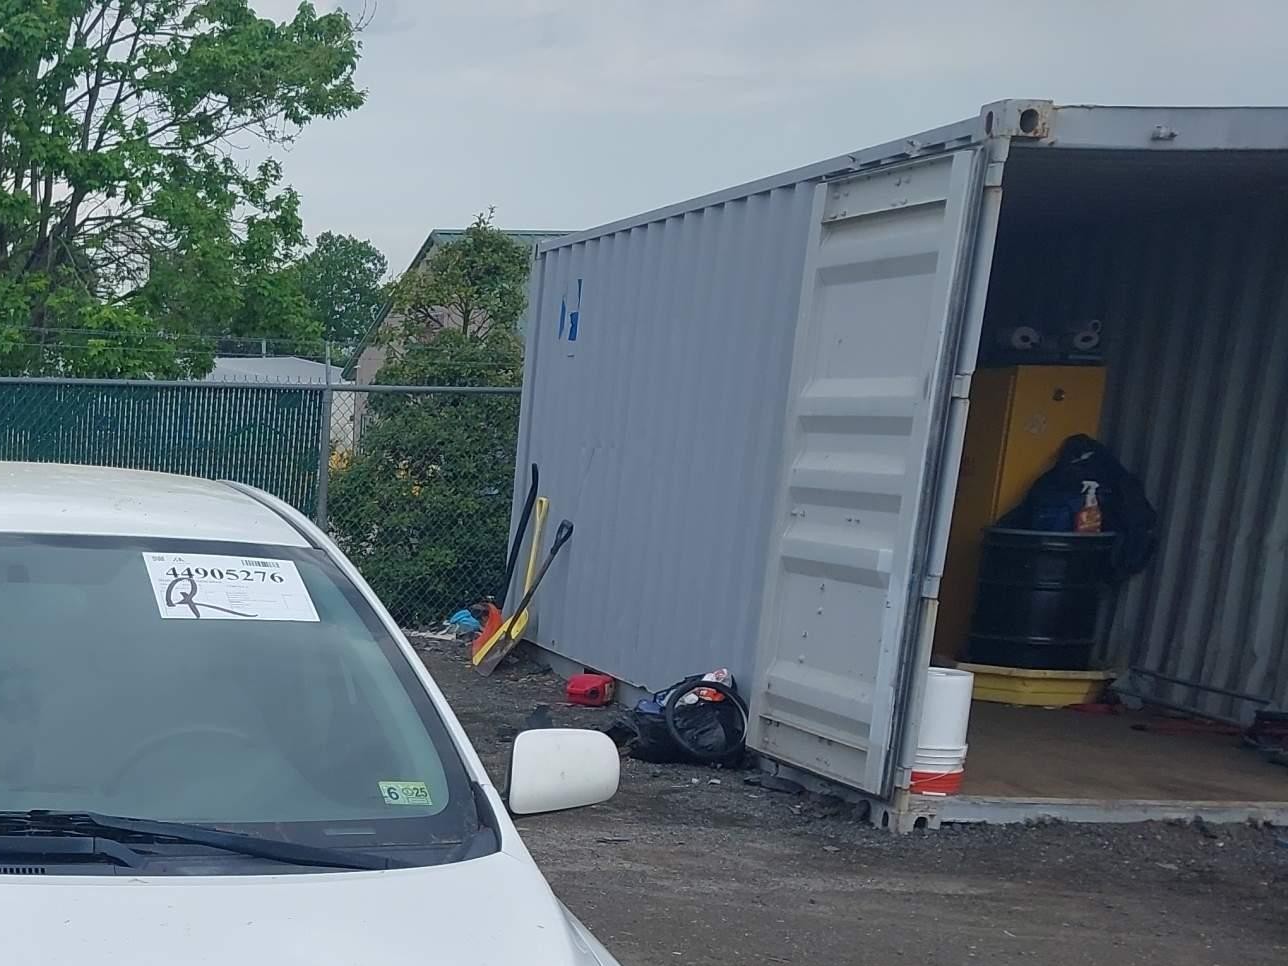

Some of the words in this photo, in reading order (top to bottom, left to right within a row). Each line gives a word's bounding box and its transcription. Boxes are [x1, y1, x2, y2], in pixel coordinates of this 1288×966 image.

[165, 566, 284, 584] 44905276
[386, 786, 400, 800] 6
[412, 786, 428, 798] 25
